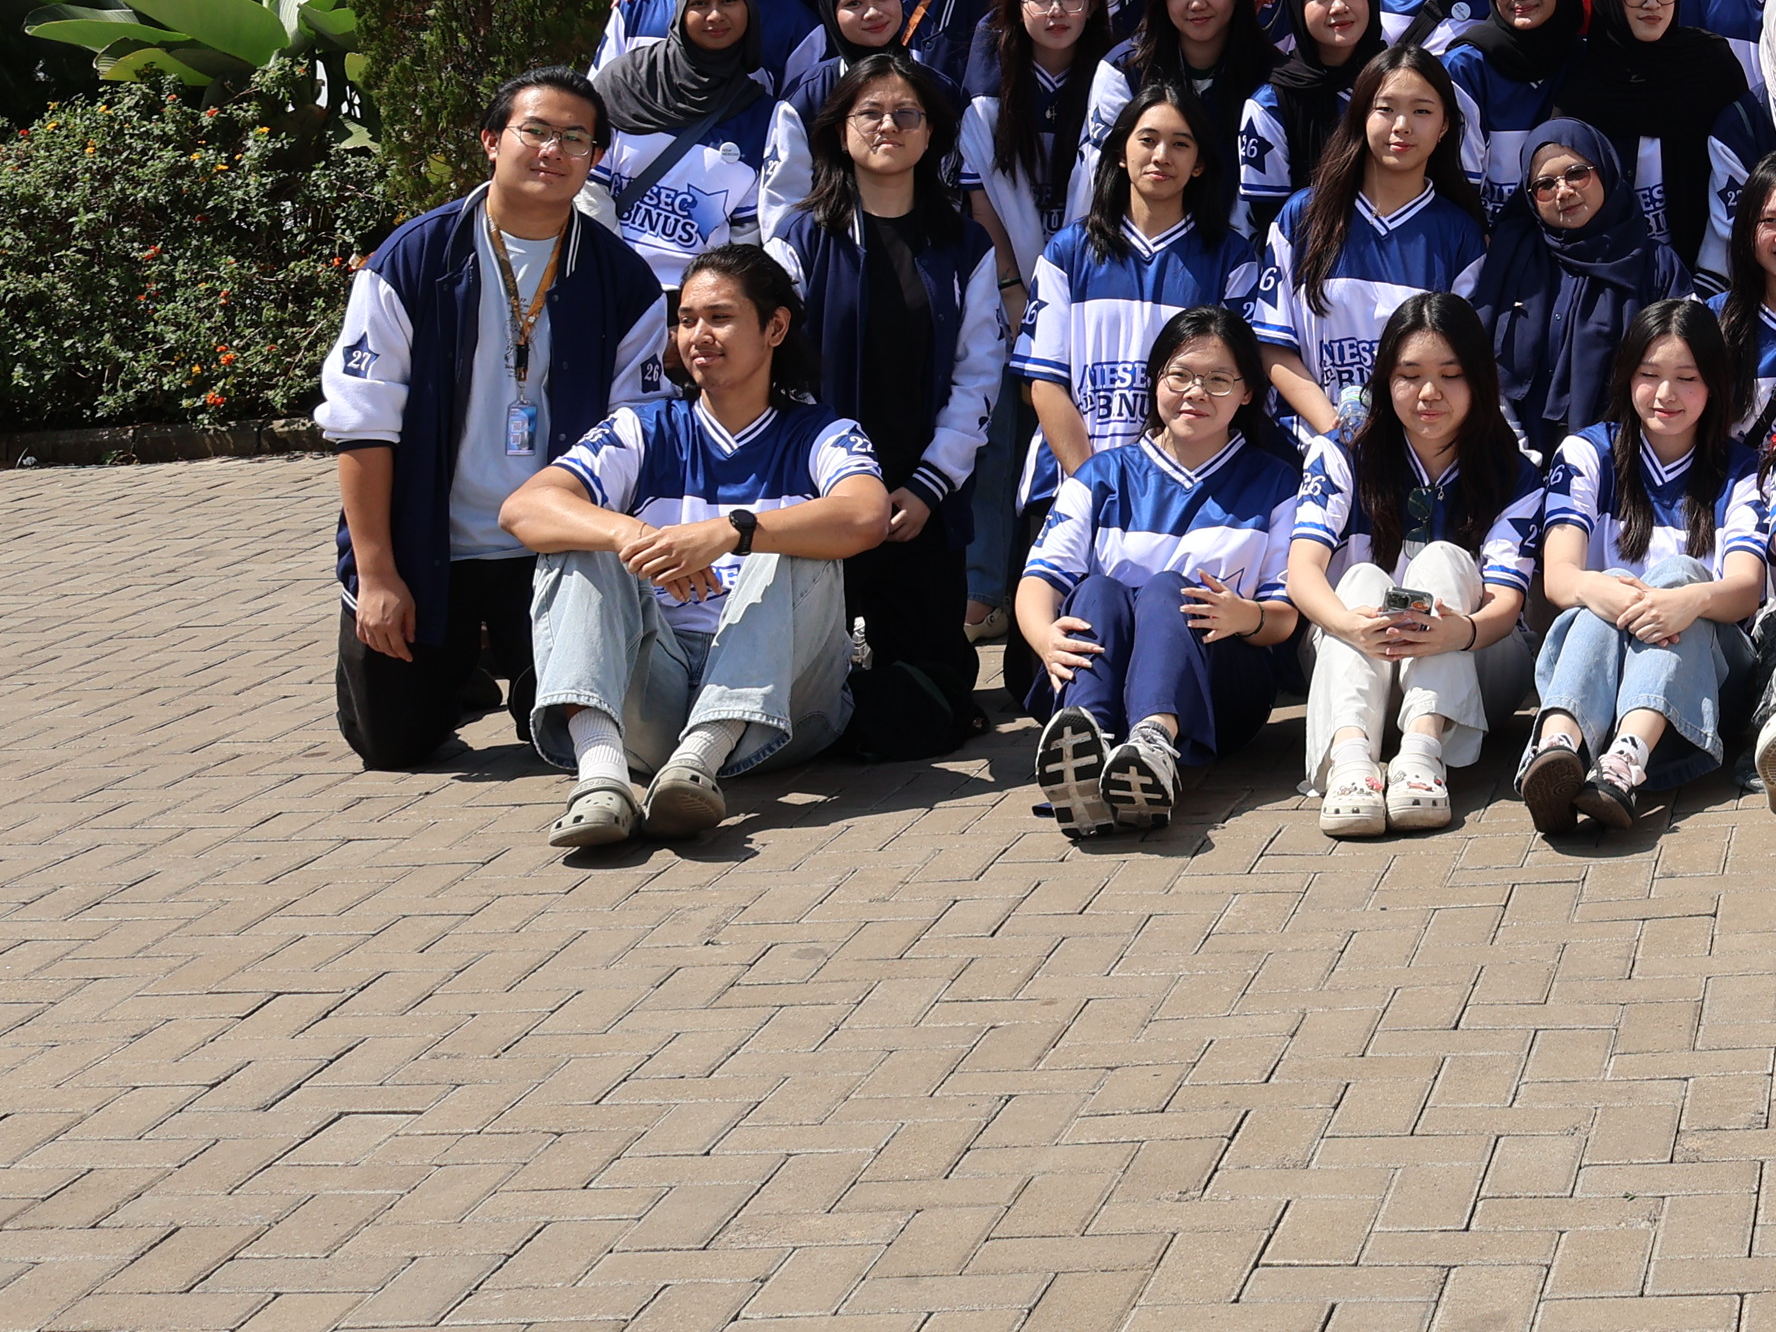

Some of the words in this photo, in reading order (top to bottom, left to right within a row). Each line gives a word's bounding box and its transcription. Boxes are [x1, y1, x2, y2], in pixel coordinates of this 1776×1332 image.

[611, 173, 694, 216] ASEC
[622, 208, 698, 245] BINUS
[1259, 266, 1277, 290] 6
[1242, 301, 1255, 324] 2
[348, 350, 372, 372] 27
[644, 362, 660, 382] 26
[1078, 364, 1148, 391] AIESE
[1549, 465, 1565, 485] 6
[1523, 524, 1537, 548] 2
